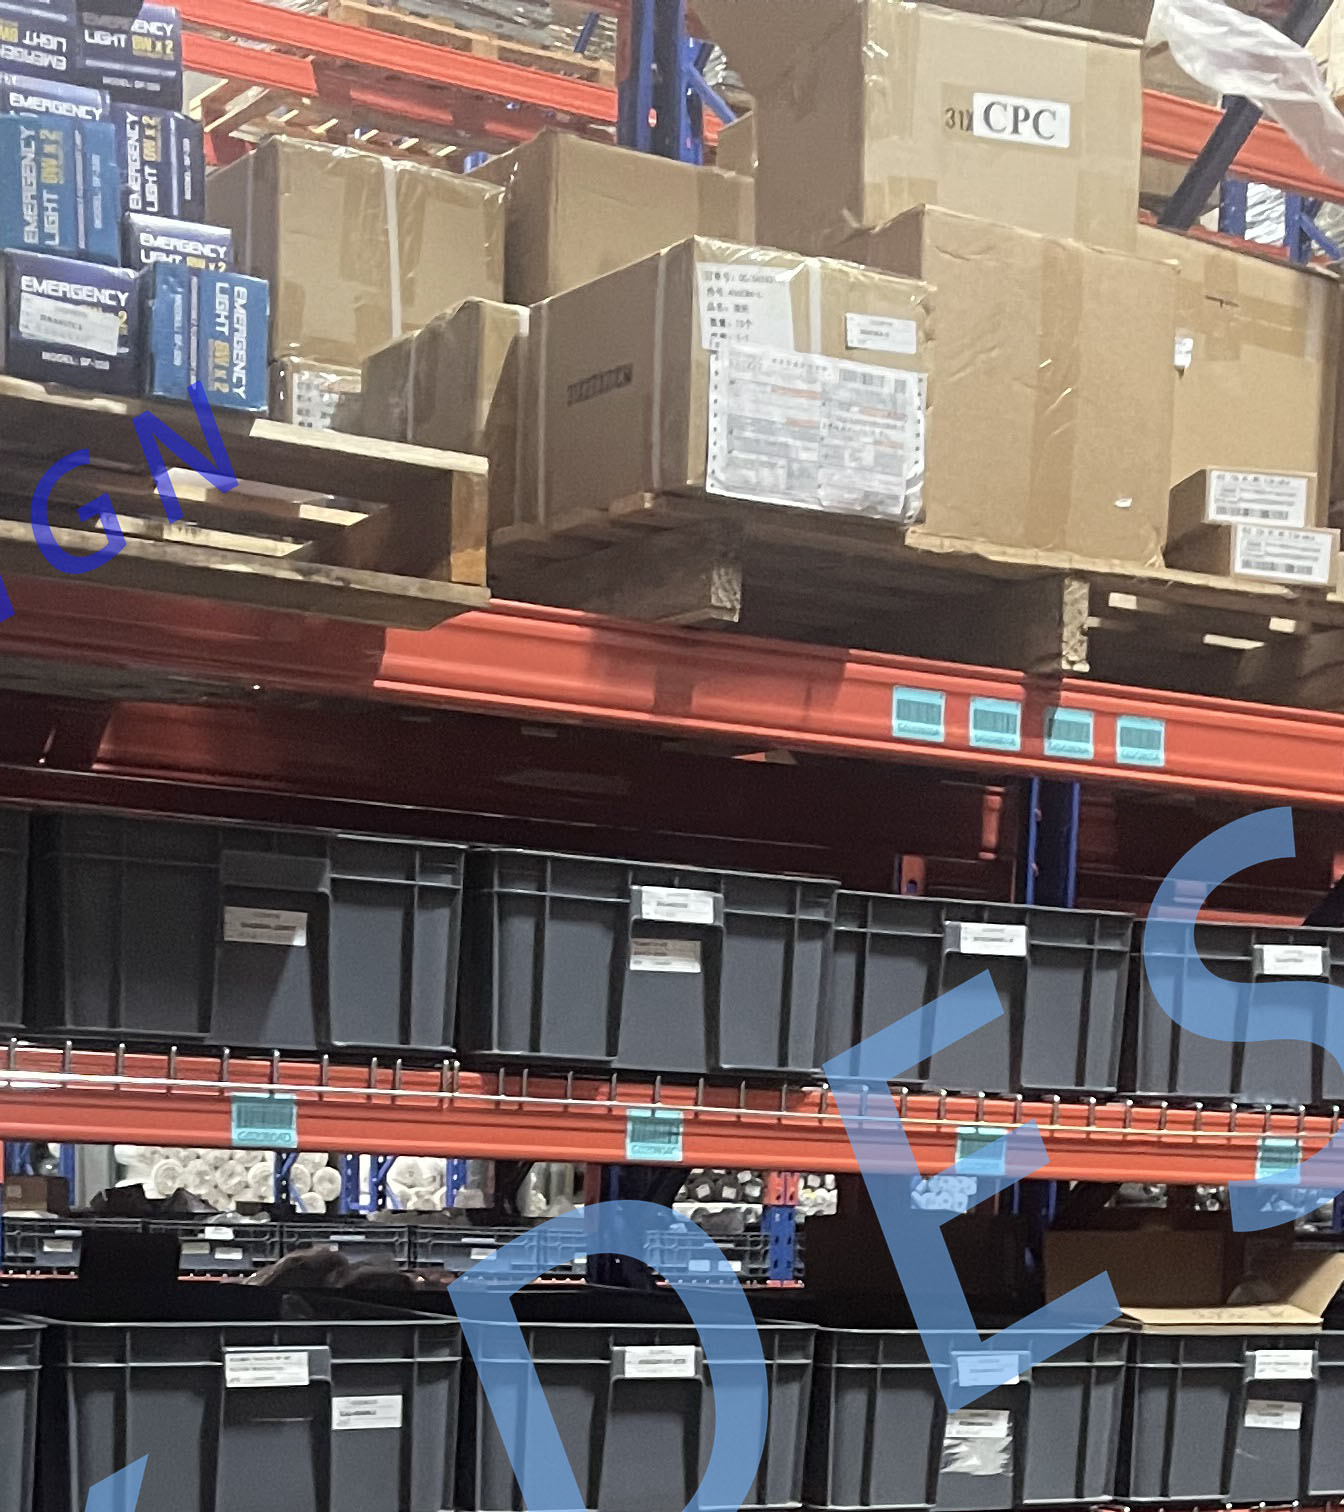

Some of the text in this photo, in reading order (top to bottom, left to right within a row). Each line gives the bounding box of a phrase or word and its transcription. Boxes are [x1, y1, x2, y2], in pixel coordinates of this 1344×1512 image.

[22, 31, 67, 53] LIGHT
[84, 29, 127, 48] LIGHT
[9, 92, 103, 121] EMERGENCY
[982, 101, 1057, 141] CPC
[126, 111, 143, 210] EMERGENCY
[19, 124, 40, 245] EMERGENCY
[144, 165, 159, 212] LIGHT
[42, 188, 60, 246] LIGHT
[139, 232, 227, 259] EMERGENCY
[21, 275, 130, 307] EMERGENCY
[214, 281, 230, 337] LIGHT
[232, 285, 249, 400] EMERGENCY
